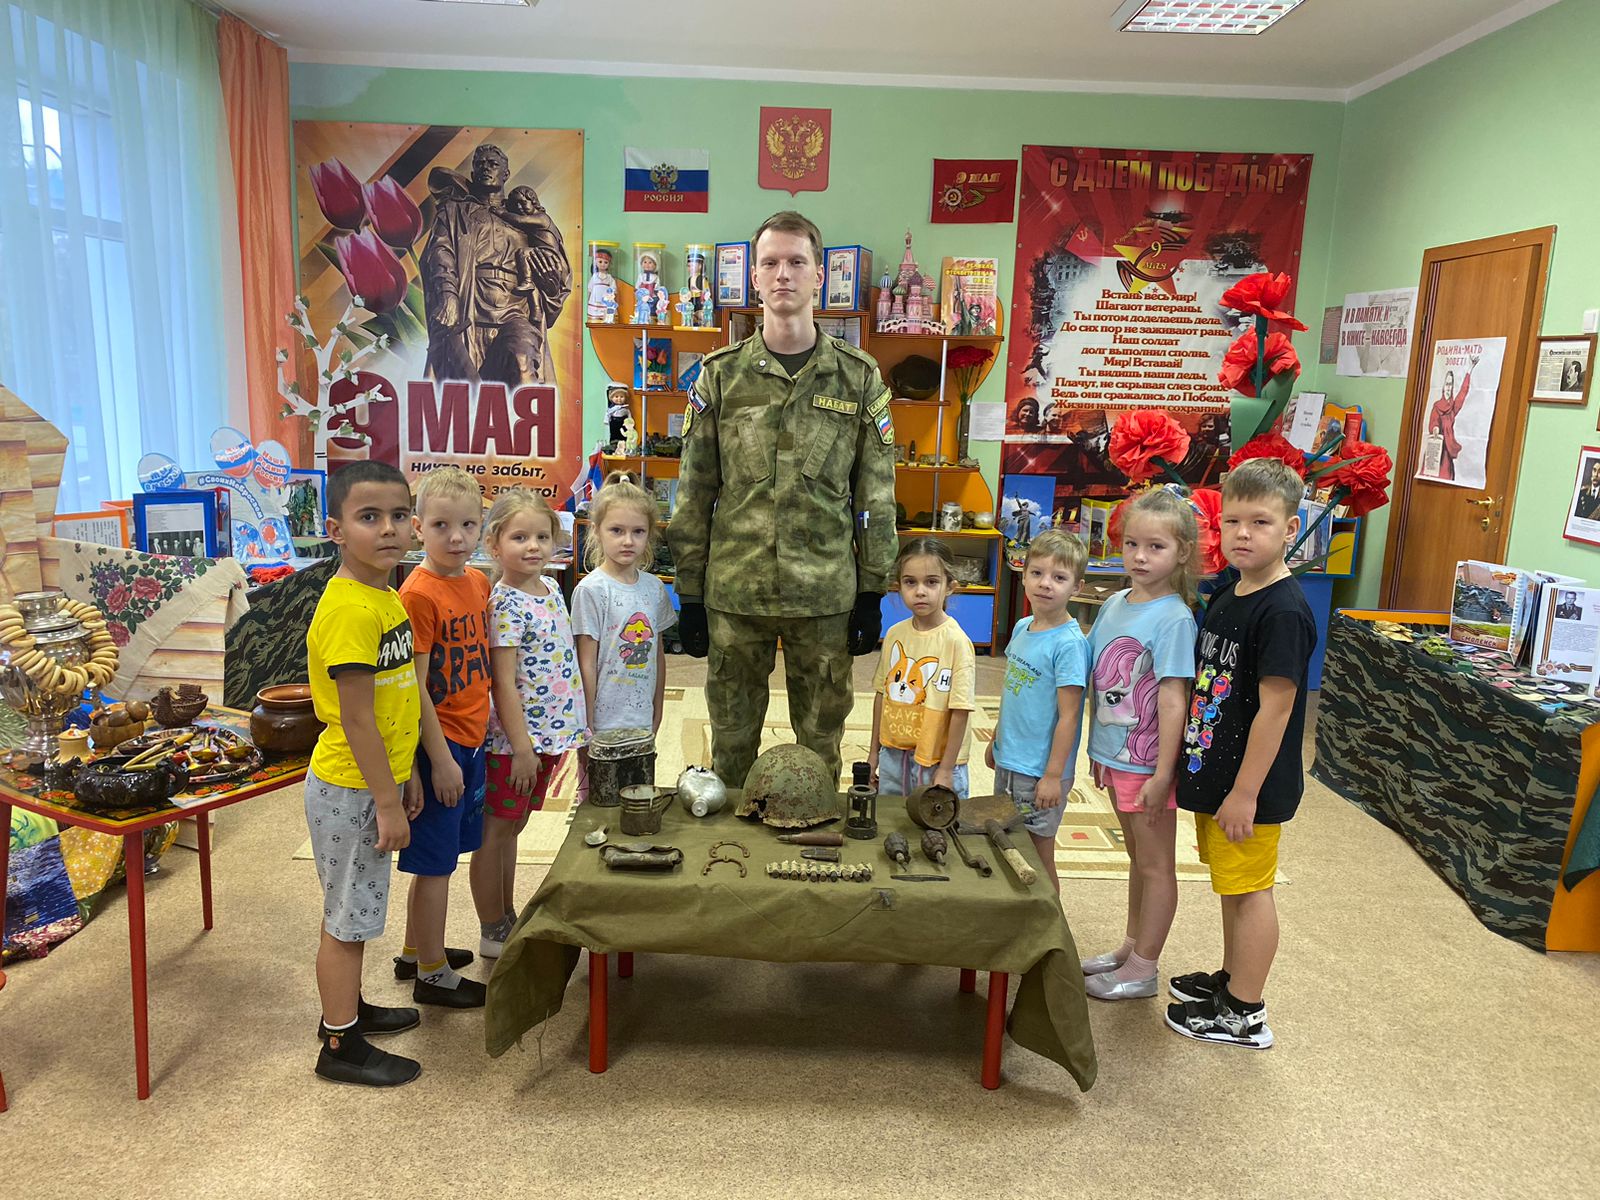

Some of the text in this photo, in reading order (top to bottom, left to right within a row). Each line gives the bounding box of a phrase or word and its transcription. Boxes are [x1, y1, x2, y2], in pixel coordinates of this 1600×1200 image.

[956, 171, 1001, 184] 9 МАЯ
[1050, 157, 1287, 197] С ДНЕМ ПОБЕДЫ!
[644, 193, 684, 202] РОССИЯ
[1151, 241, 1162, 257] 9
[1102, 289, 1197, 303] Встань весь мир!
[1096, 301, 1143, 311] Шагают
[1074, 311, 1092, 321] Ты
[1093, 313, 1129, 322] потом
[1130, 314, 1193, 324] доделаешь
[1060, 322, 1077, 332] До
[1101, 325, 1122, 334] пор
[1124, 325, 1138, 333] не
[1139, 326, 1199, 335] заживают
[1113, 334, 1180, 346] Наш солдат
[1371, 329, 1407, 347] НАВСЕГДА
[1081, 347, 1107, 355] долг
[1109, 348, 1166, 357] выполнил
[1437, 344, 1483, 355] РОДИНА-МАТЬ
[1103, 357, 1183, 368] Мир! Вставай!
[1078, 367, 1096, 377] Ты
[1098, 370, 1142, 378] видишь
[1143, 371, 1175, 379] наши
[1115, 382, 1165, 391] скрывая
[1051, 388, 1079, 398] Ведь
[1080, 391, 1102, 399] они
[1103, 392, 1166, 401] сражались
[818, 398, 853, 411] НАБАТ
[1053, 399, 1095, 409] Жизни
[1096, 402, 1128, 410] наши
[327, 371, 556, 477] 9 МАЯ
[466, 464, 486, 475] не
[491, 462, 546, 480] забыт,
[1461, 635, 1497, 647] СМОЛЕНСК
[1220, 638, 1240, 669] US
